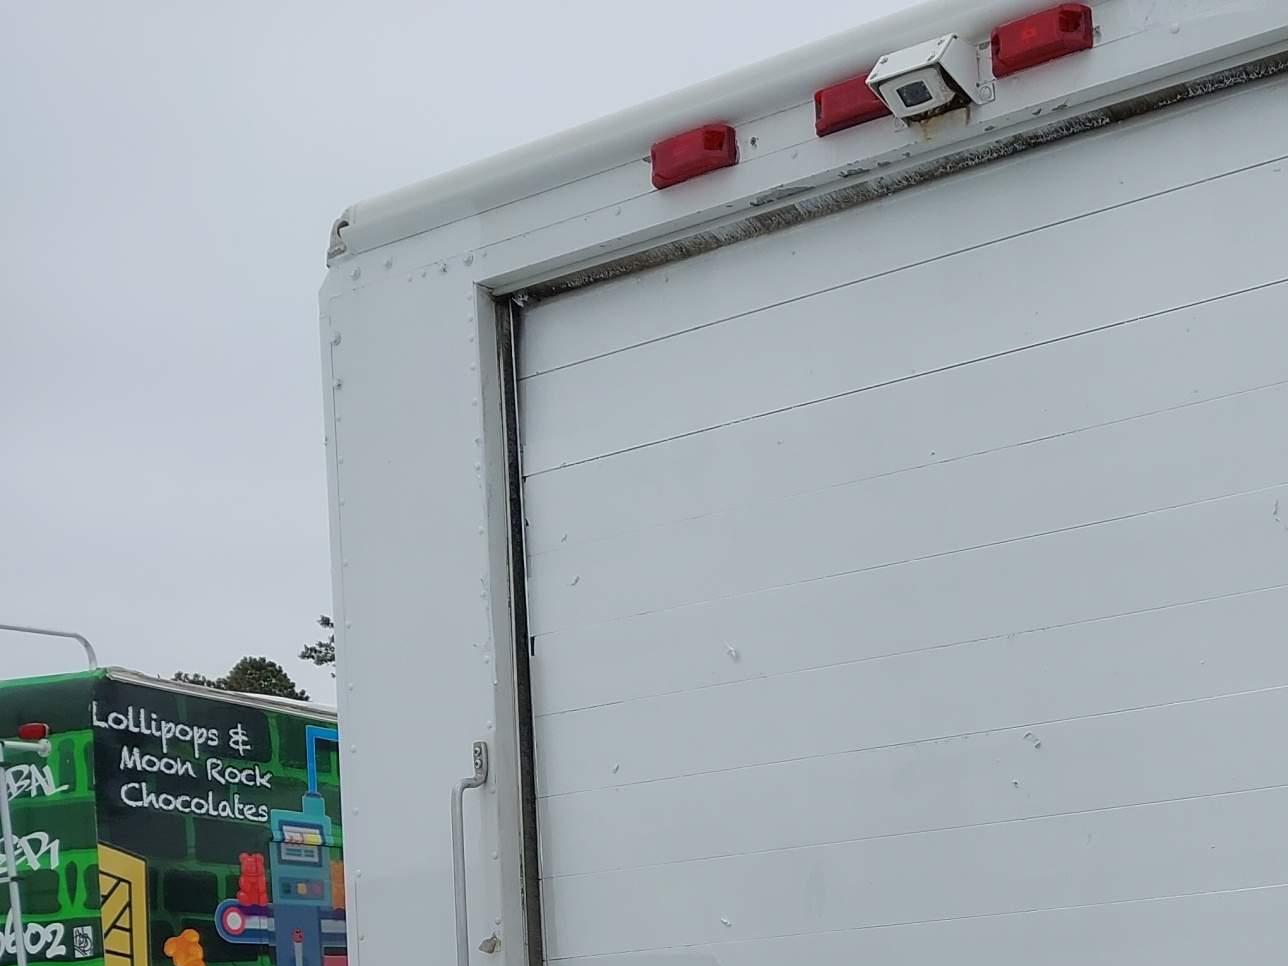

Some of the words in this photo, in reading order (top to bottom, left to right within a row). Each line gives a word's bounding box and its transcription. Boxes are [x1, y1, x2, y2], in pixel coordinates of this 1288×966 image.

[92, 700, 219, 759] Lollipops
[229, 723, 251, 757] &
[119, 745, 197, 778] Moon
[206, 757, 273, 789] Rock
[120, 781, 269, 822] Chocolates
